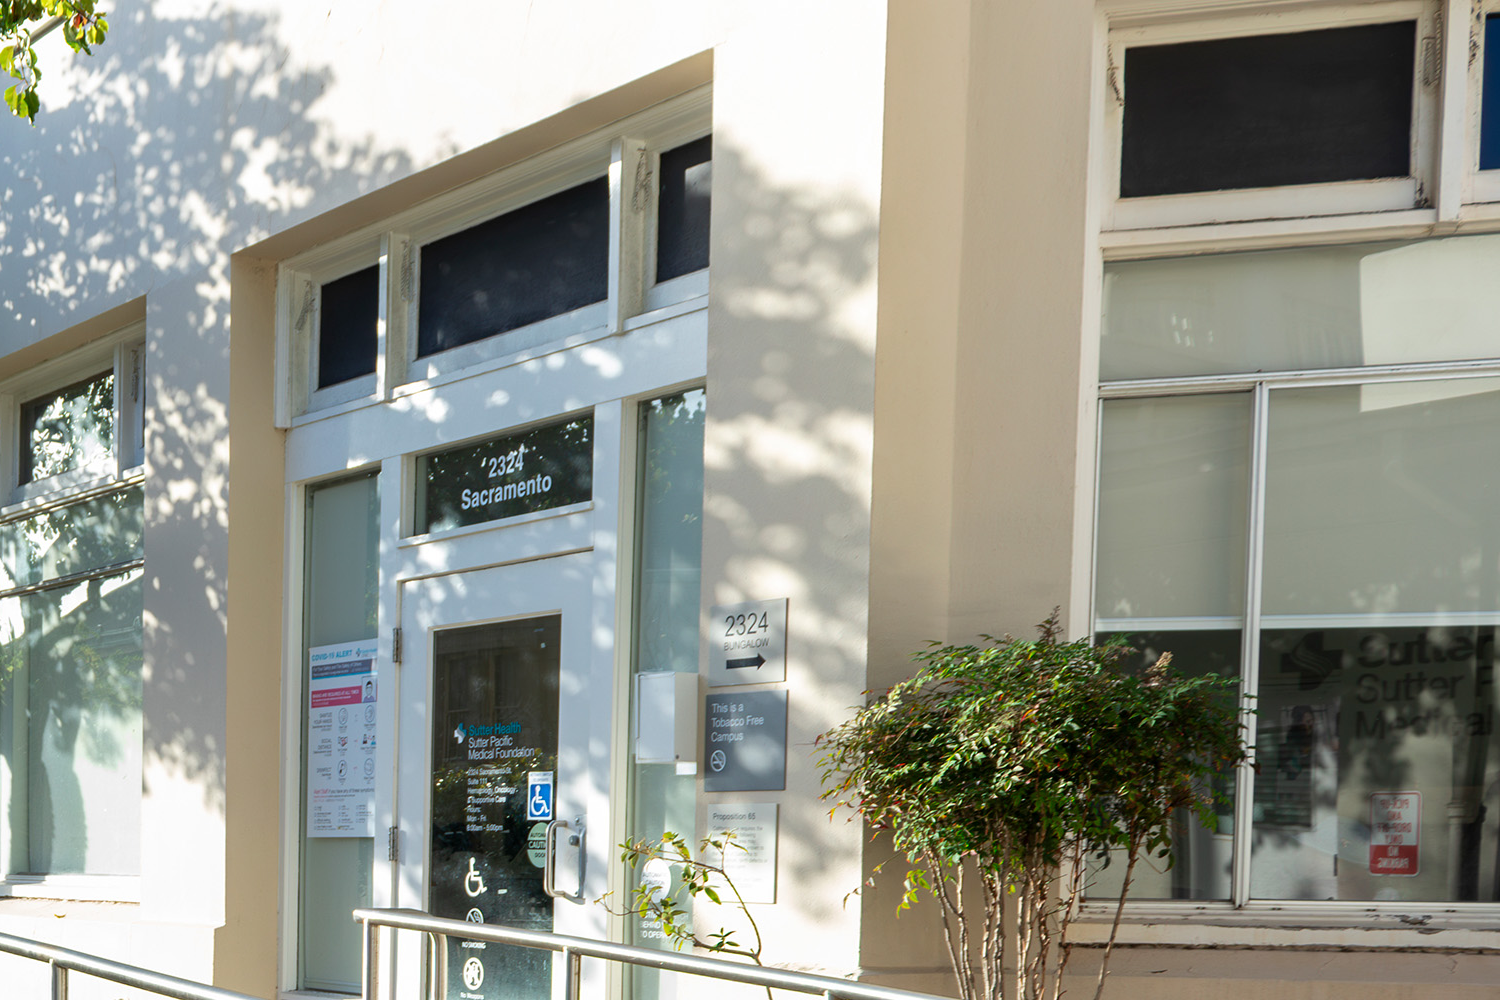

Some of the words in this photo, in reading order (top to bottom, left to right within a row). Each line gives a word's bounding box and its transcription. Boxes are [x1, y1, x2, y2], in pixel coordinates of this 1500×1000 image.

[488, 451, 524, 478] 2324
[461, 475, 552, 510] Sacramento
[725, 610, 769, 637] 2324
[723, 637, 769, 651] BUNGALOW
[335, 649, 353, 658] ALERT
[1356, 671, 1465, 704] Sutter
[711, 703, 728, 714] This
[729, 702, 737, 713] is
[738, 704, 744, 713] a
[711, 716, 745, 728] Tobacco
[746, 714, 764, 726] Free
[468, 724, 493, 737] Sutter
[494, 721, 522, 735] Health
[468, 736, 489, 749] Sutter
[489, 734, 513, 747] Pacific
[711, 731, 744, 744] Campus
[468, 748, 495, 760] Medical
[495, 746, 535, 759] Foundation
[712, 812, 747, 822] Proposition
